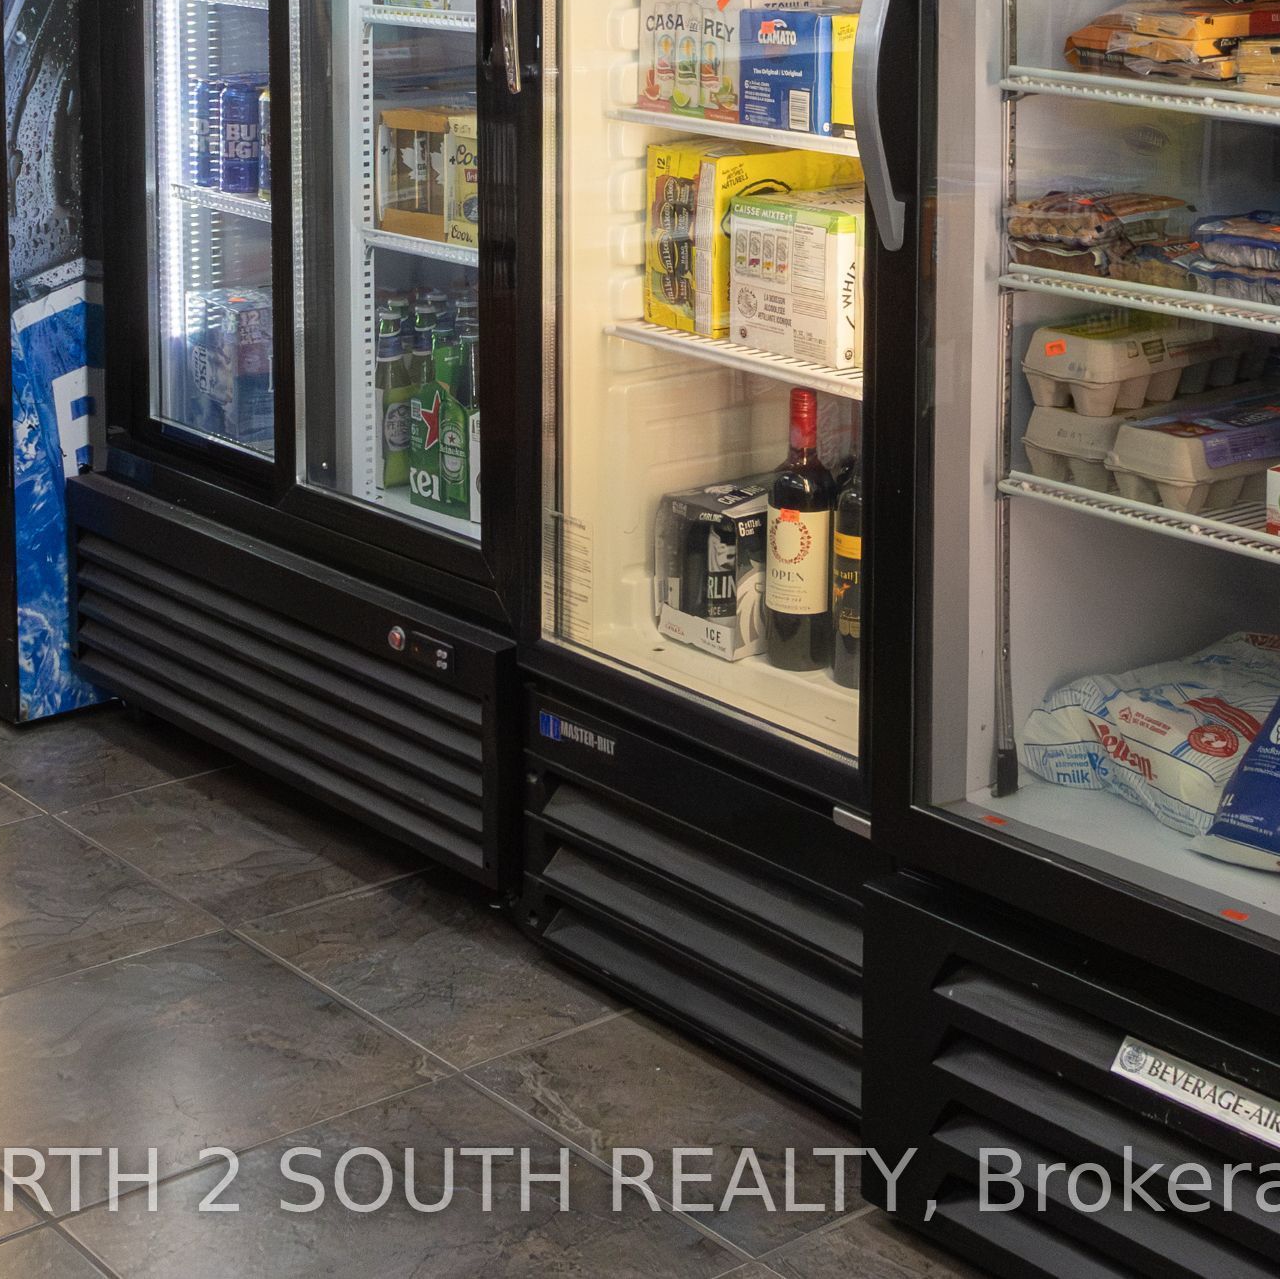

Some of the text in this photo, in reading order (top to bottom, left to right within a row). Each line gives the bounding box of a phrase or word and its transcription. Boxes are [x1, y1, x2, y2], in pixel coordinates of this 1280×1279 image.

[646, 14, 735, 42] CASA REY
[823, 122, 830, 132] 6
[656, 158, 666, 170] 12
[734, 204, 761, 217] CAISSE
[738, 521, 745, 537] 6
[771, 569, 805, 582] OPEN
[708, 576, 736, 599] RLIN
[705, 627, 722, 644] ICE
[560, 719, 616, 756] MASTER-BILT
[1056, 770, 1091, 784] milk
